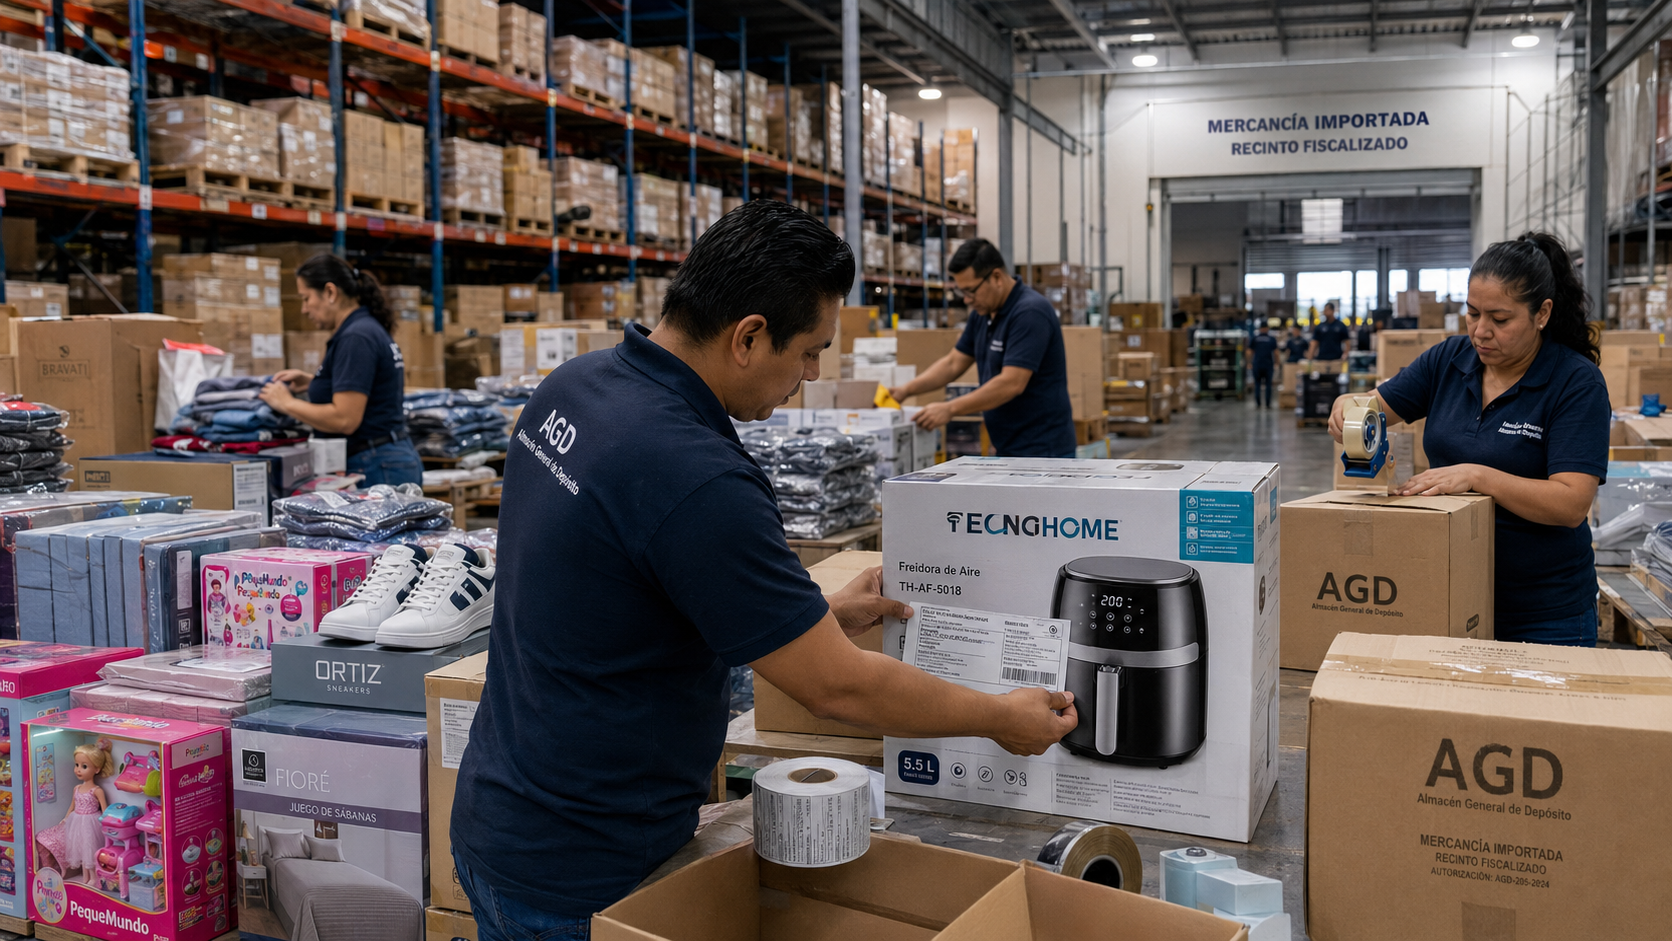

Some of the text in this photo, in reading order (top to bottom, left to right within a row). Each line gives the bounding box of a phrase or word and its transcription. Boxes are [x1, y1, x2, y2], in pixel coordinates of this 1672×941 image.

[1207, 111, 1430, 134] MERCANCÍA IMPORTADA
[1231, 136, 1409, 156] RECINTO FISCALIZADO
[538, 408, 577, 455] AGD
[898, 561, 981, 577] Freidora de Aire
[899, 581, 962, 596] TH-AF-5018
[1316, 571, 1398, 606] AGD
[1100, 594, 1124, 608] 200
[1311, 602, 1339, 612] Almacén
[1339, 604, 1365, 614] General
[1365, 606, 1374, 615] de
[315, 660, 382, 685] ORTIZ
[326, 684, 371, 695] SNEAKERS
[903, 756, 935, 773] 5.5 L
[1424, 738, 1564, 800] AGD
[275, 768, 331, 793] FIORÉ
[289, 802, 377, 823] JUEGO DE SÁBANAS
[1417, 792, 1572, 821] Almacén General de Depósito
[1420, 833, 1564, 862] MERCANCÍA IMPORTADA
[1431, 866, 1493, 882] AUTORIZACIÓN:
[1435, 852, 1547, 875] RECINTO FISCALIZADO
[70, 900, 150, 935] PequeMundo
